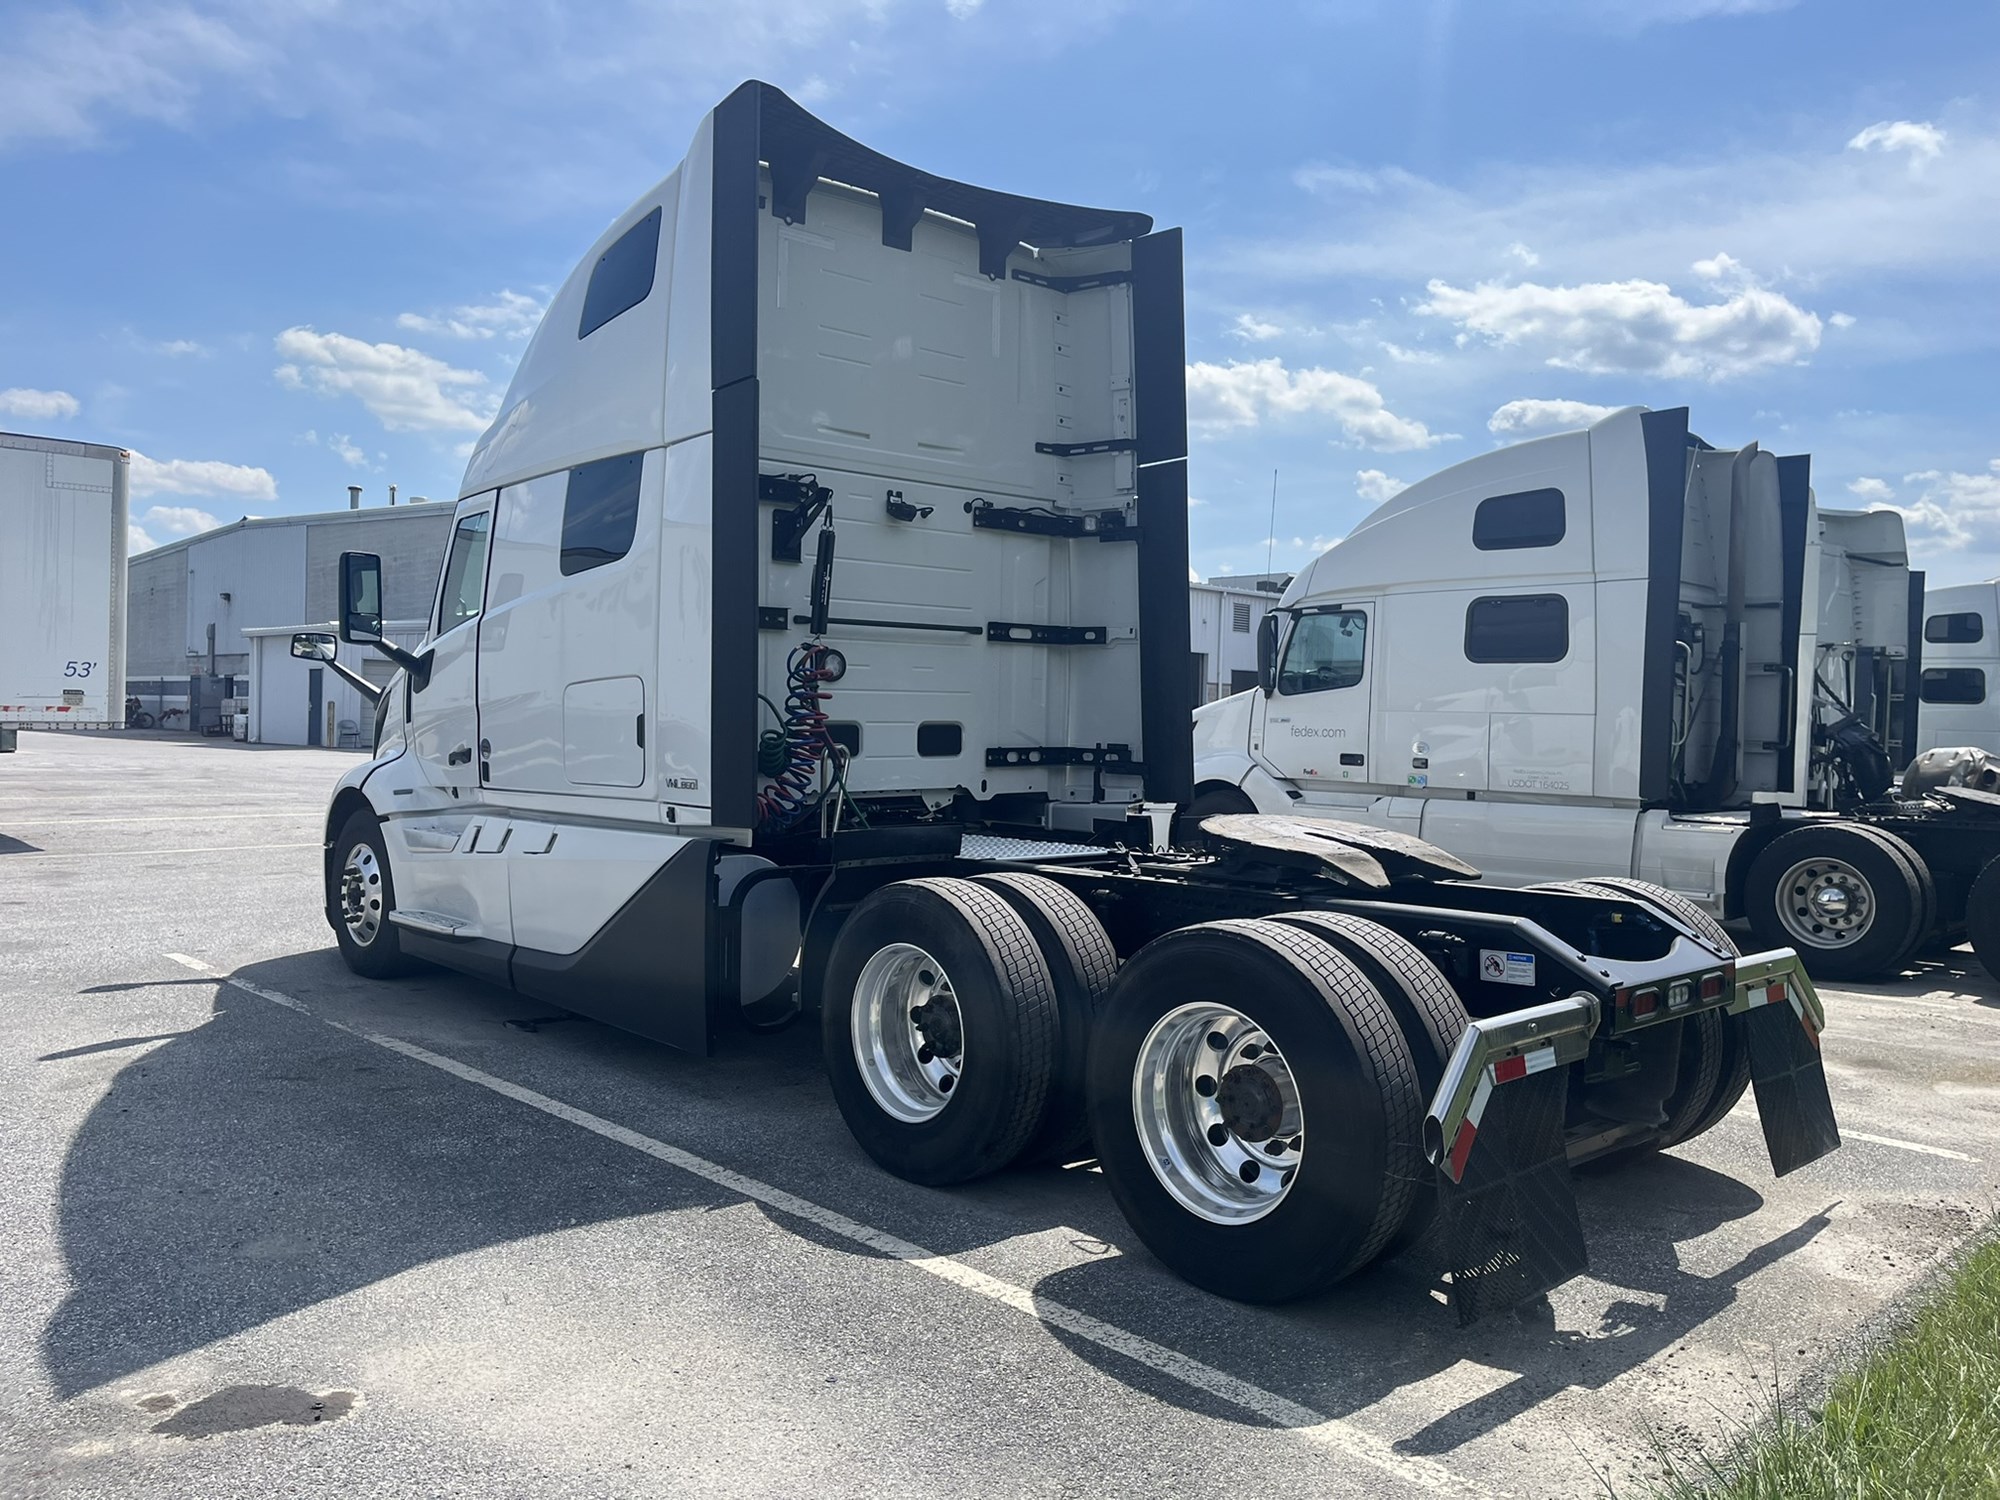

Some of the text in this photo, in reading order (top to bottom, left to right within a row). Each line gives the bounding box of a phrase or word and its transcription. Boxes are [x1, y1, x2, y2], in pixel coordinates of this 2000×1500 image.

[64, 661, 97, 678] 53'
[1290, 725, 1346, 738] fedex.com
[1507, 779, 1537, 788] USDOT
